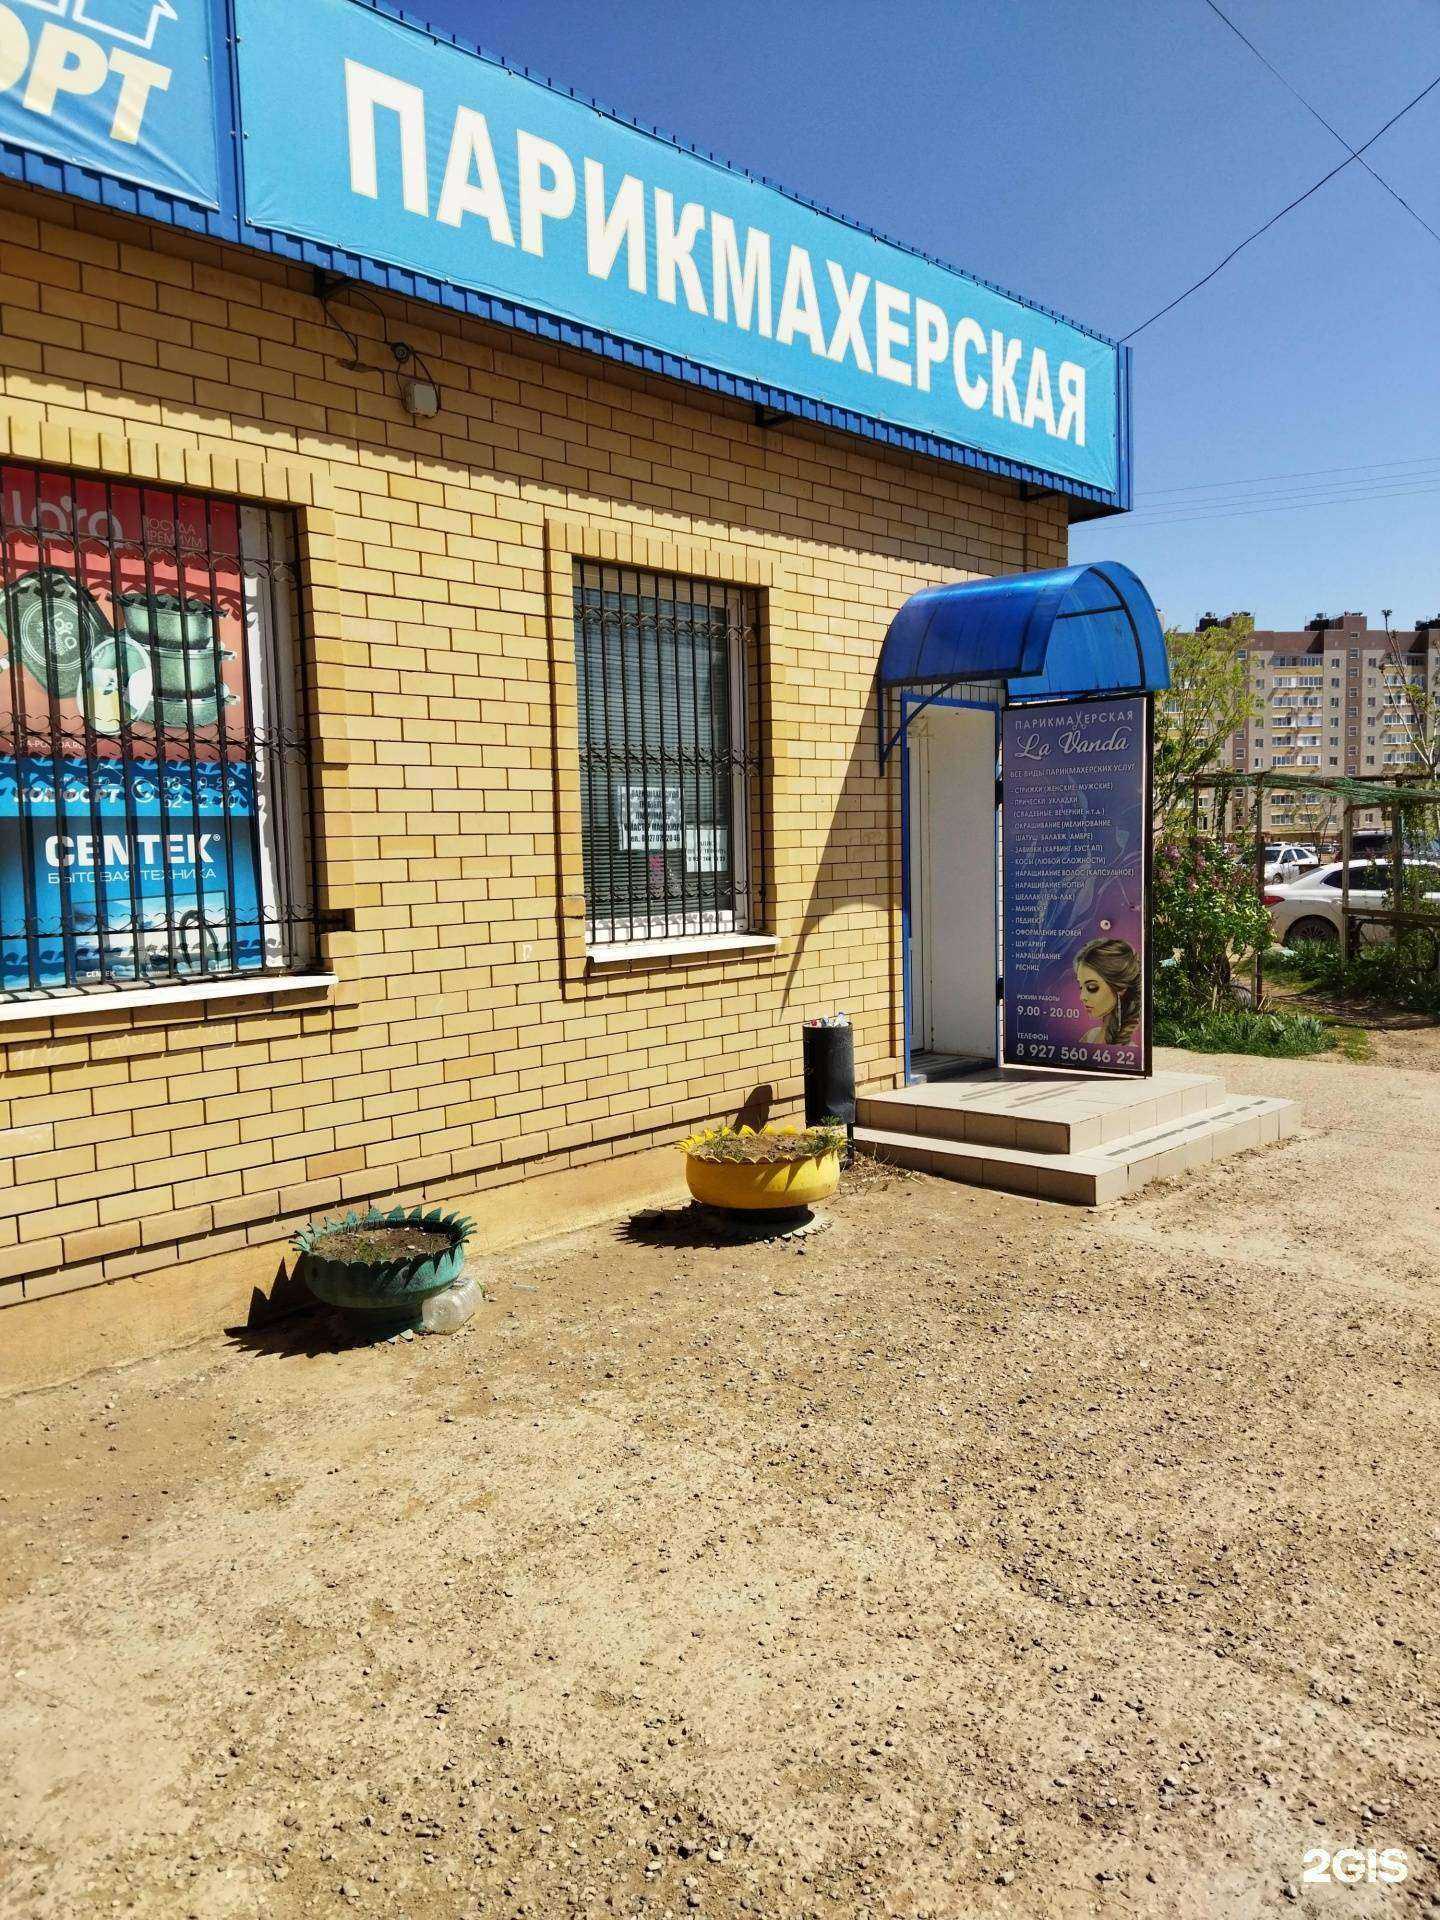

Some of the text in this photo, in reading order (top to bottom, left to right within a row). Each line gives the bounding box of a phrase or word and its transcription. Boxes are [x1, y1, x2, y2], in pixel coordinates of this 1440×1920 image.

[343, 58, 1086, 446] ПАРИКМАХЕРСКАЯ
[1015, 710, 1134, 731] ПАРИКМАХЕРСКАЯ
[1014, 726, 1133, 761] La Vanda
[48, 867, 217, 884] БЫТОВАЯ ТЕХНИКА
[1015, 928, 1082, 937] ОФОРМЛЕНИЕ БРОВЕЙ
[1015, 952, 1061, 960] НАРАЩИВАНИЕ
[86, 970, 116, 979] CENEK
[1015, 964, 1039, 972] РЕСНИЦ
[1016, 1005, 1040, 1016] 9.00
[1050, 1007, 1080, 1019] 20.00
[1016, 1032, 1049, 1041] ТЕЛЕФОН
[1016, 1043, 1135, 1065] 8 927 560 46 22
